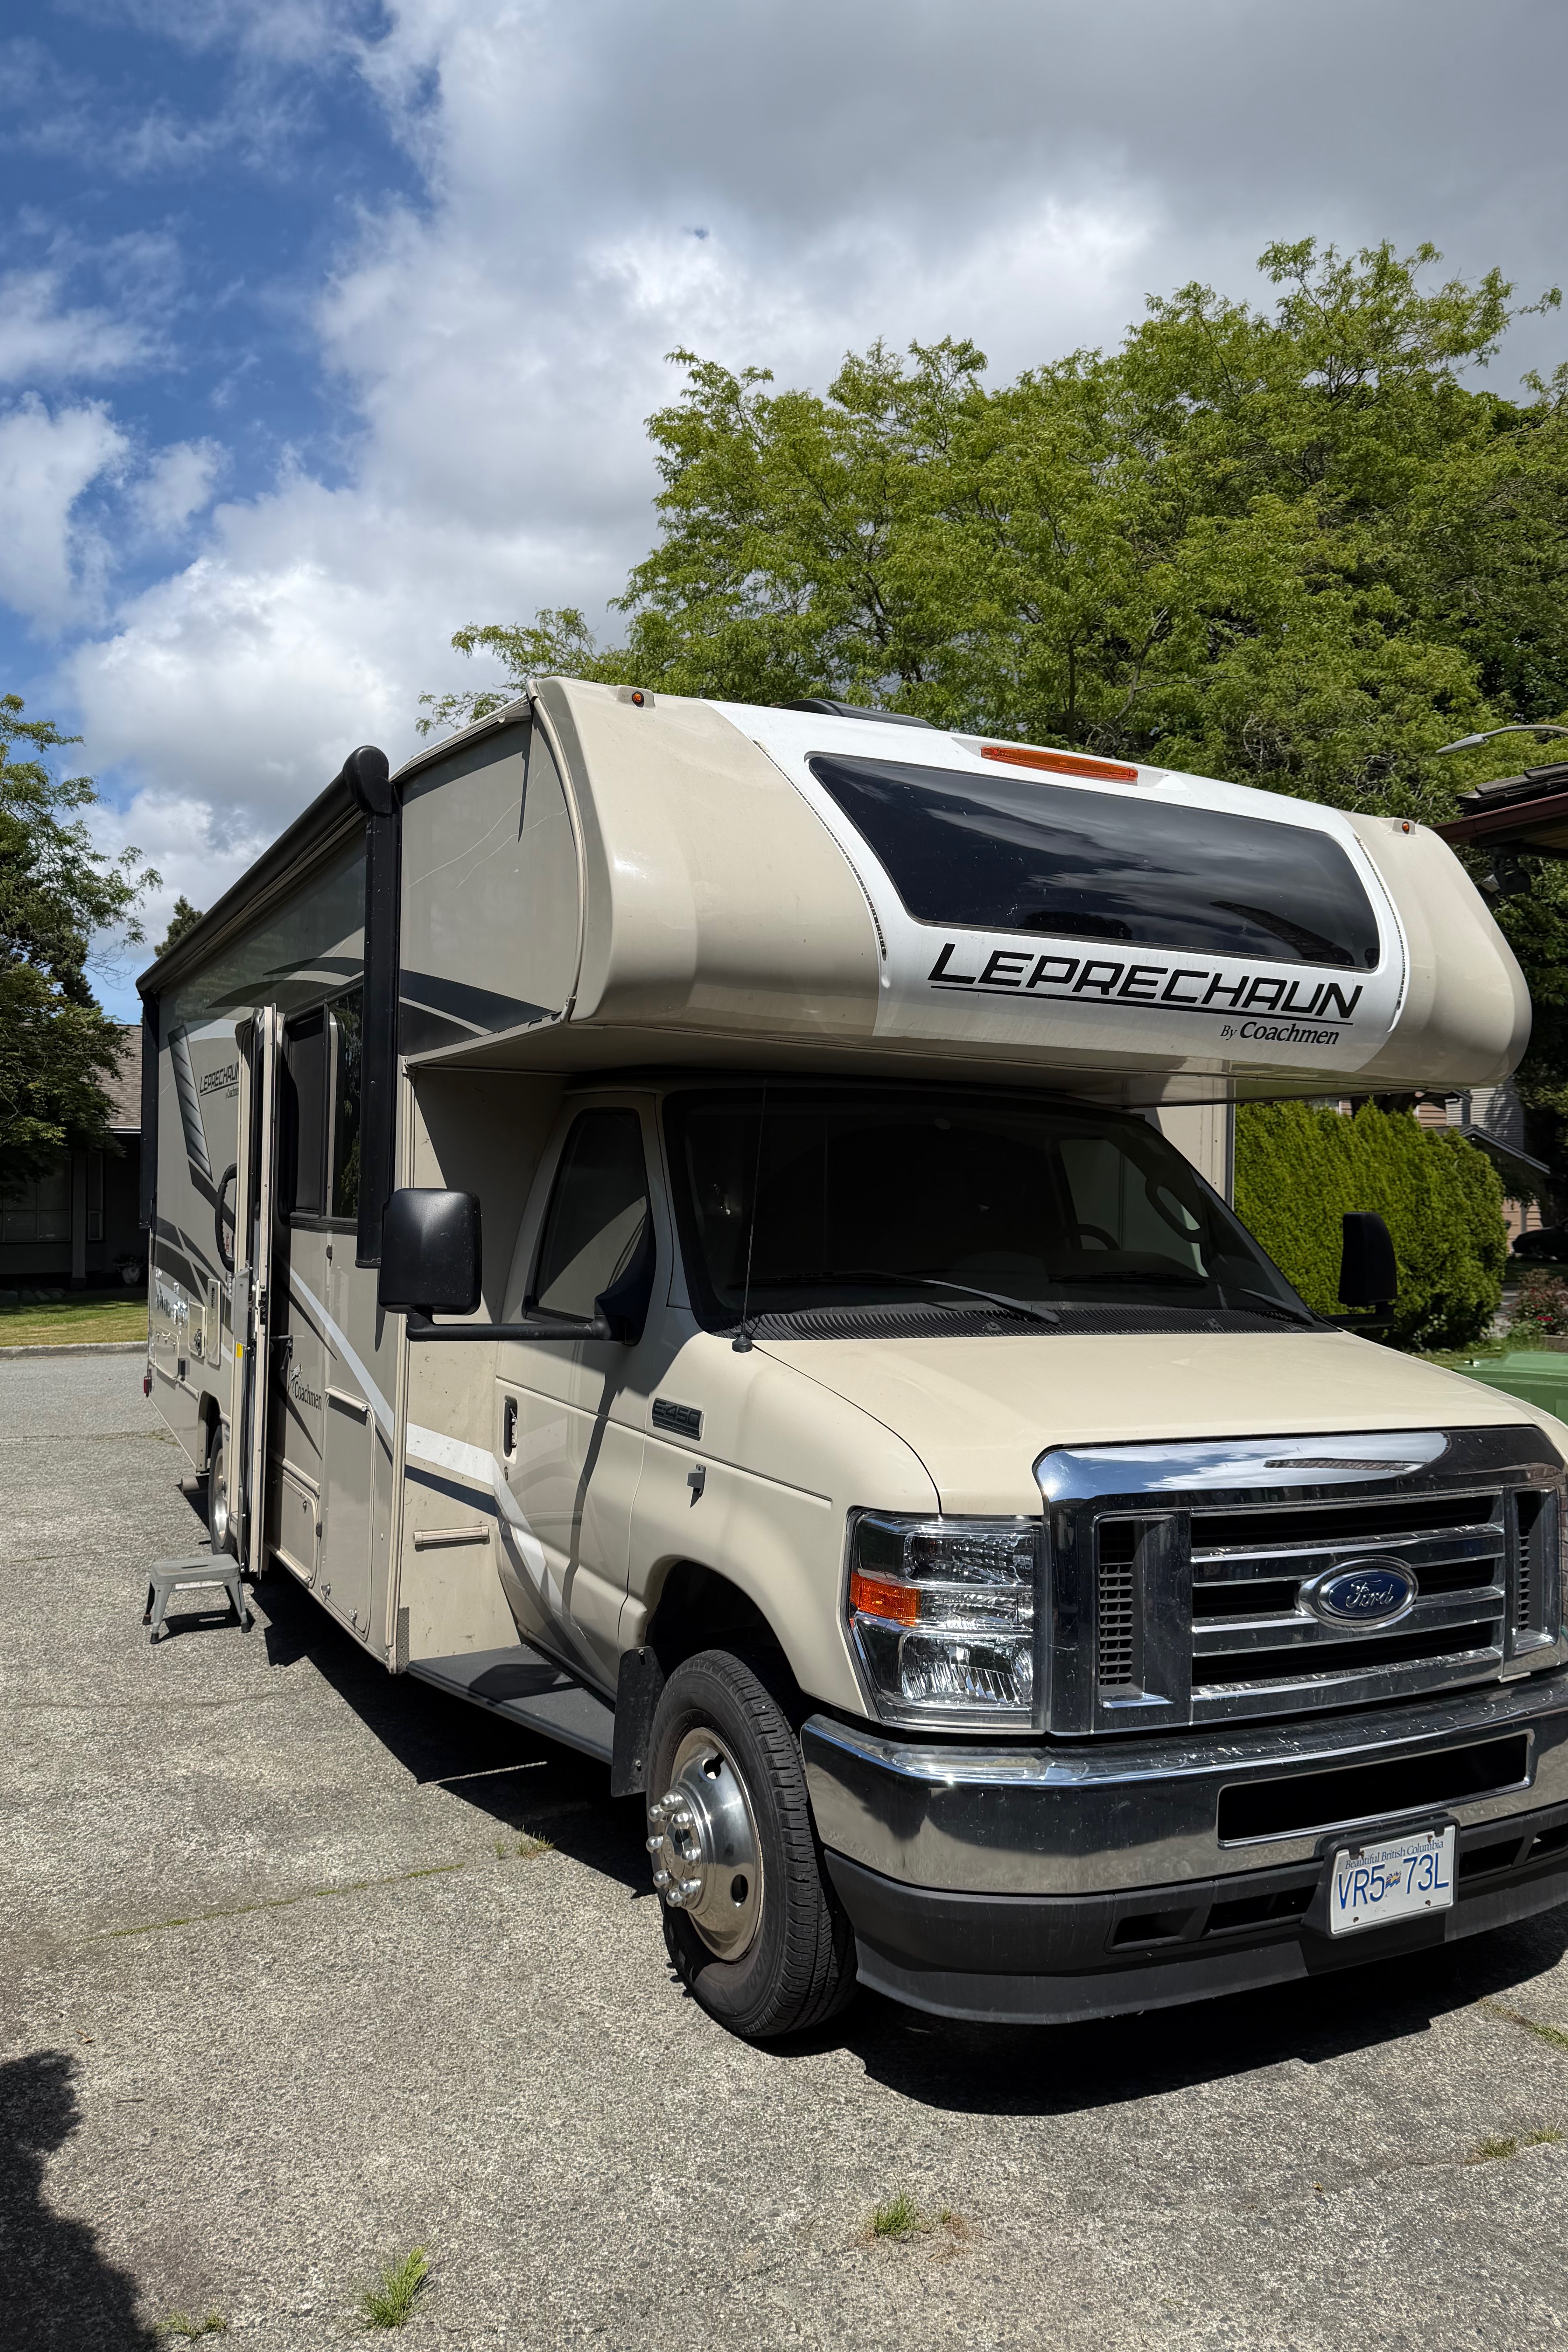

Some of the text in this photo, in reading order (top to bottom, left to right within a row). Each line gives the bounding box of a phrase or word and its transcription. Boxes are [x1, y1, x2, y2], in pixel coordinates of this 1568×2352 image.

[927, 943, 1363, 1019] LEPRECHAUN
[1220, 1021, 1339, 1045] By Coachmen
[295, 1381, 322, 1411] Coachmen
[1346, 1580, 1394, 1608] Ford
[1345, 1839, 1443, 1869] Beautiful British Columbia
[1338, 1852, 1449, 1910] VR5 73L
